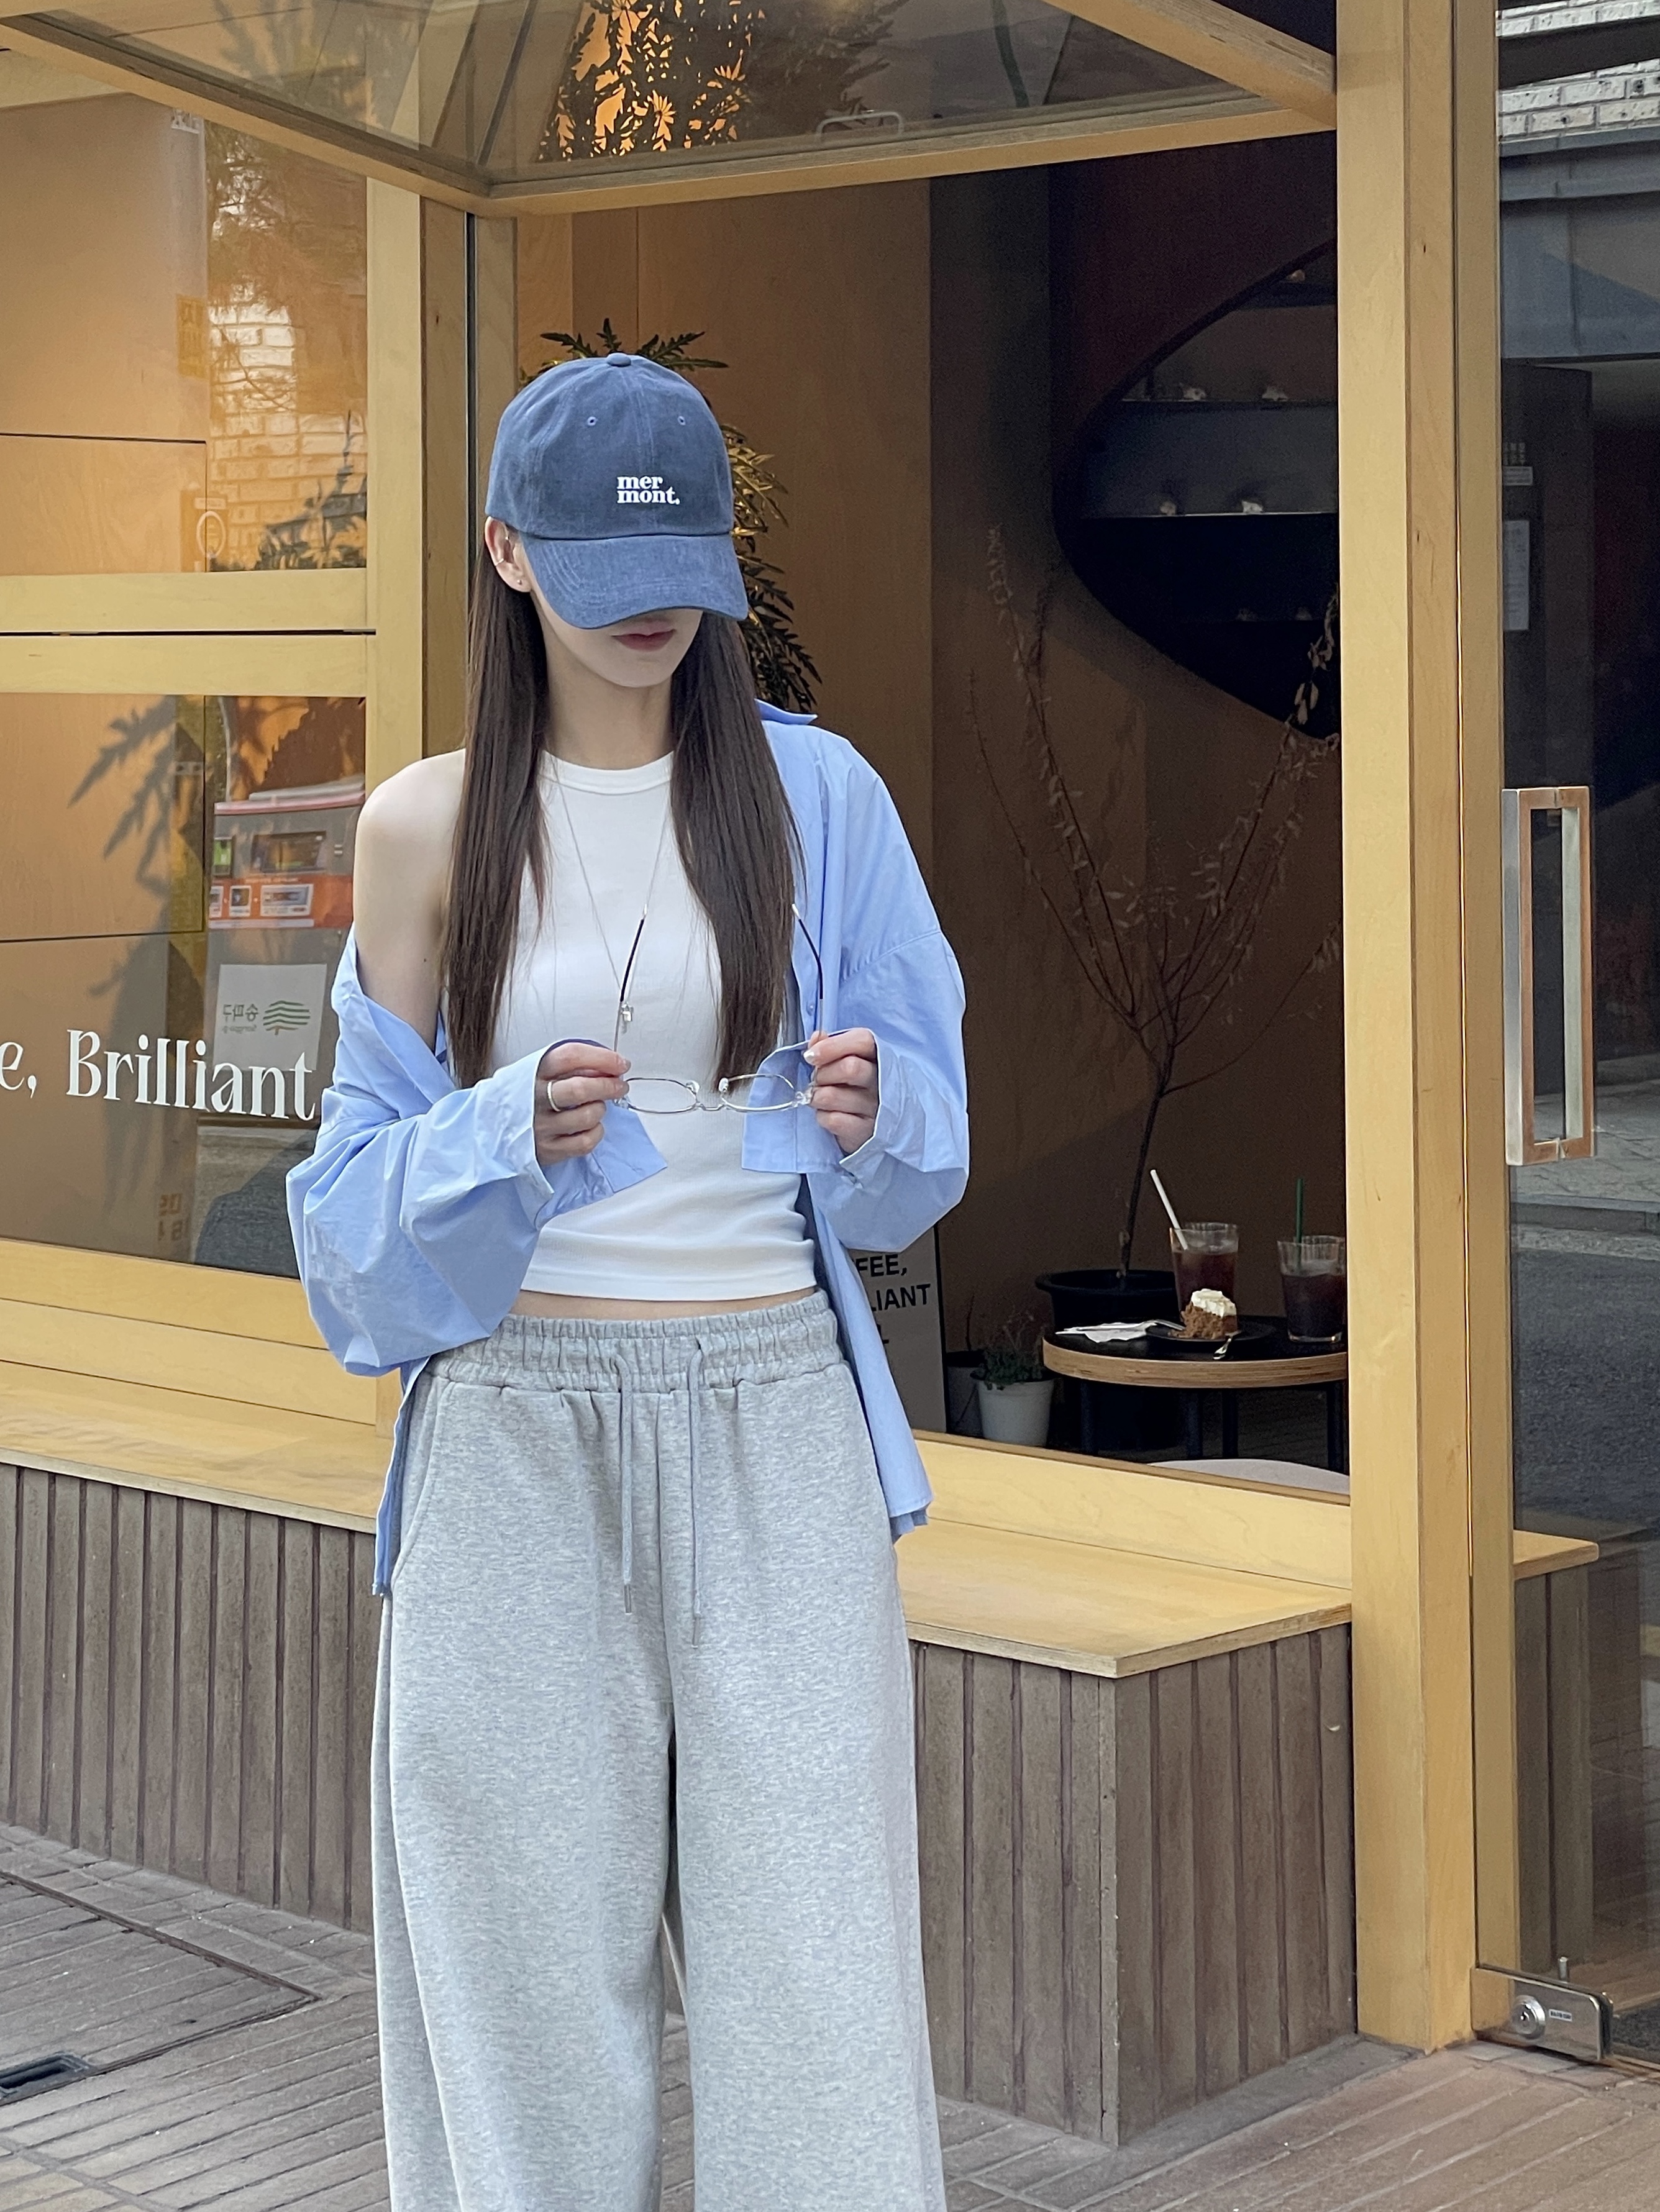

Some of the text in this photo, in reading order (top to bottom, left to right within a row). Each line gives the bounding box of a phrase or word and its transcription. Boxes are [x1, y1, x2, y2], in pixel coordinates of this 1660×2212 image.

[616, 476, 663, 489] mer
[616, 486, 681, 505] mont.
[66, 1029, 316, 1121] Brilliant
[852, 1254, 908, 1277] FEE,
